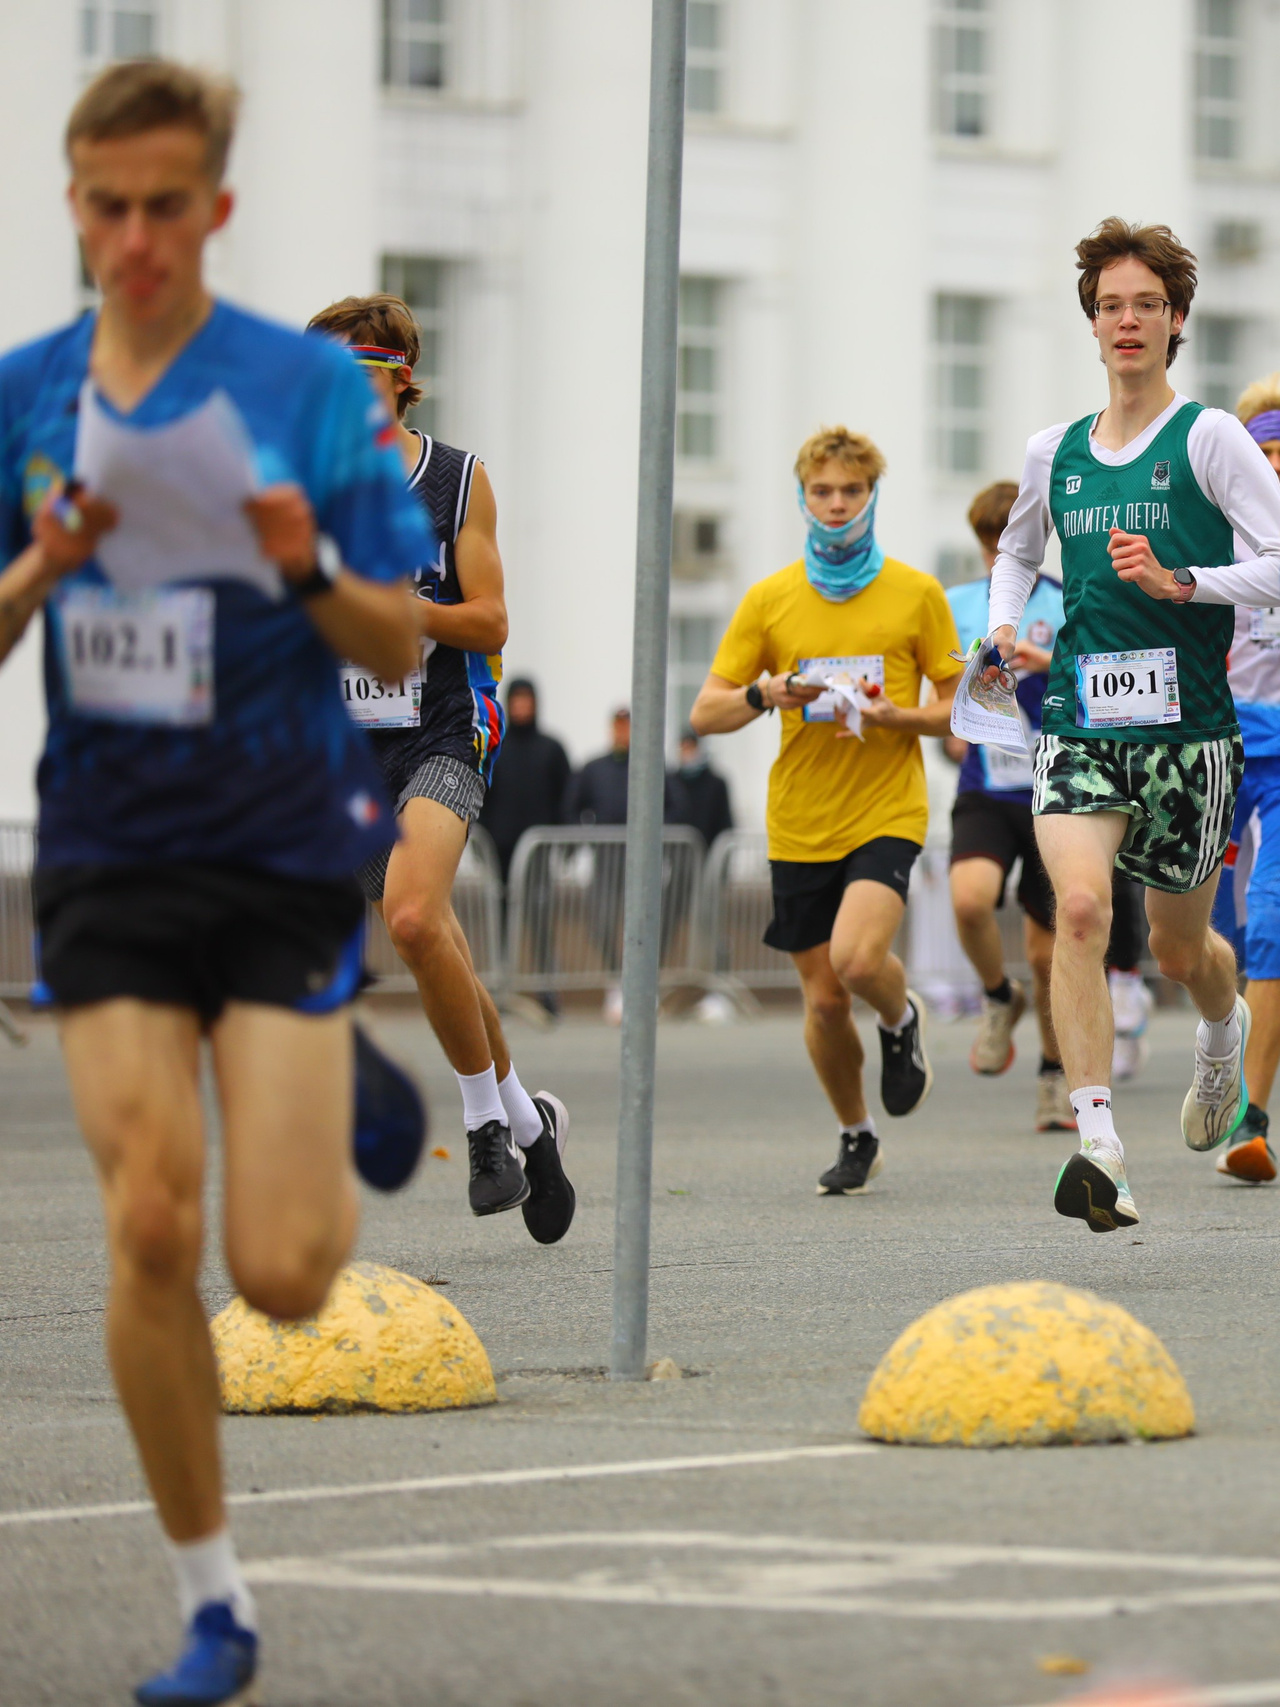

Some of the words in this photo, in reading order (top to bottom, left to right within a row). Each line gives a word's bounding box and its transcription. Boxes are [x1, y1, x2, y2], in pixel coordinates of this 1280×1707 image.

[1063, 505, 1120, 538] ПОЛИТЕХ
[1126, 503, 1170, 530] ПЕТРА
[72, 621, 177, 669] 102.1
[343, 677, 408, 701] 103.1
[1090, 670, 1160, 698] 109.1
